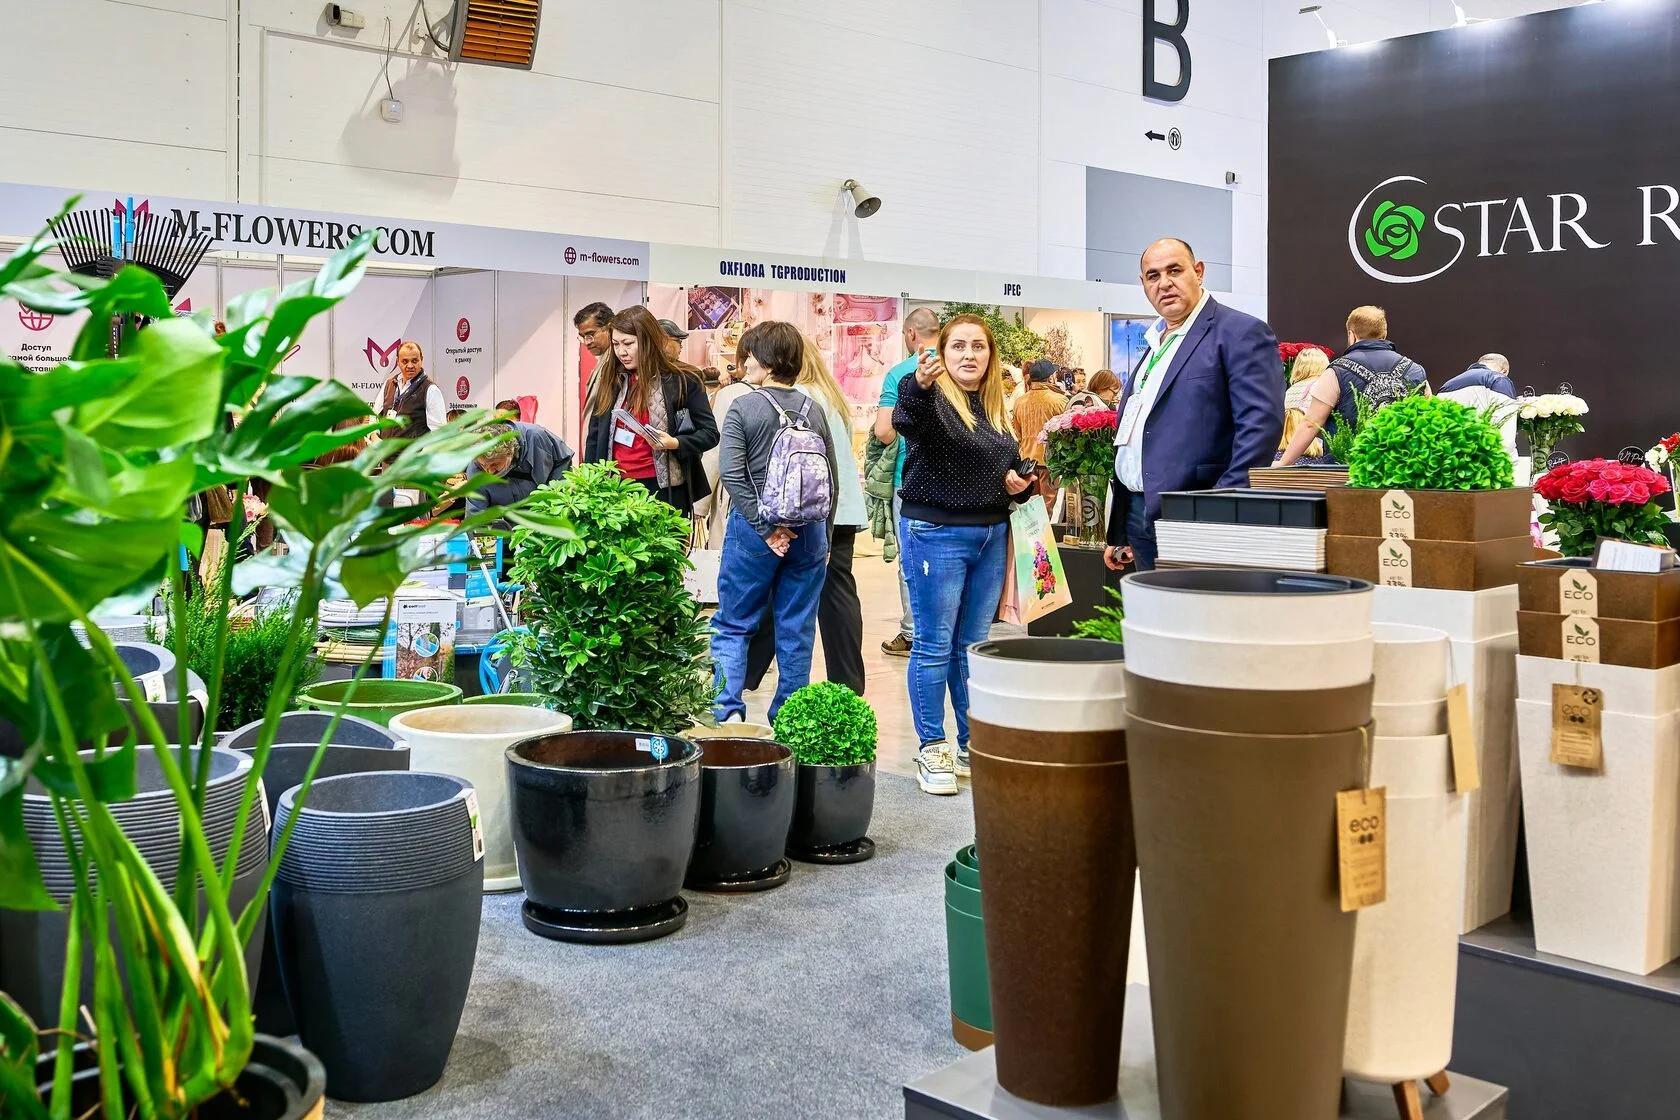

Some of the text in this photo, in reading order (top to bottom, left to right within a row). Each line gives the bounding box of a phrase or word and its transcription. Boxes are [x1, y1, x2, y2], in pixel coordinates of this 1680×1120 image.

[1143, 0, 1191, 101] B
[171, 208, 435, 258] M-FLOWERSCOM
[580, 252, 639, 266] m-flowers.com
[720, 260, 846, 284] OXFLORA TGPRODUCTION
[1003, 283, 1022, 297] JPEC
[21, 343, 52, 352] Доступ
[1385, 511, 1411, 519] ECO
[1383, 558, 1408, 567] ECO
[1564, 590, 1593, 600] ECO
[1566, 635, 1596, 646] ECO
[1349, 815, 1379, 833] eco
